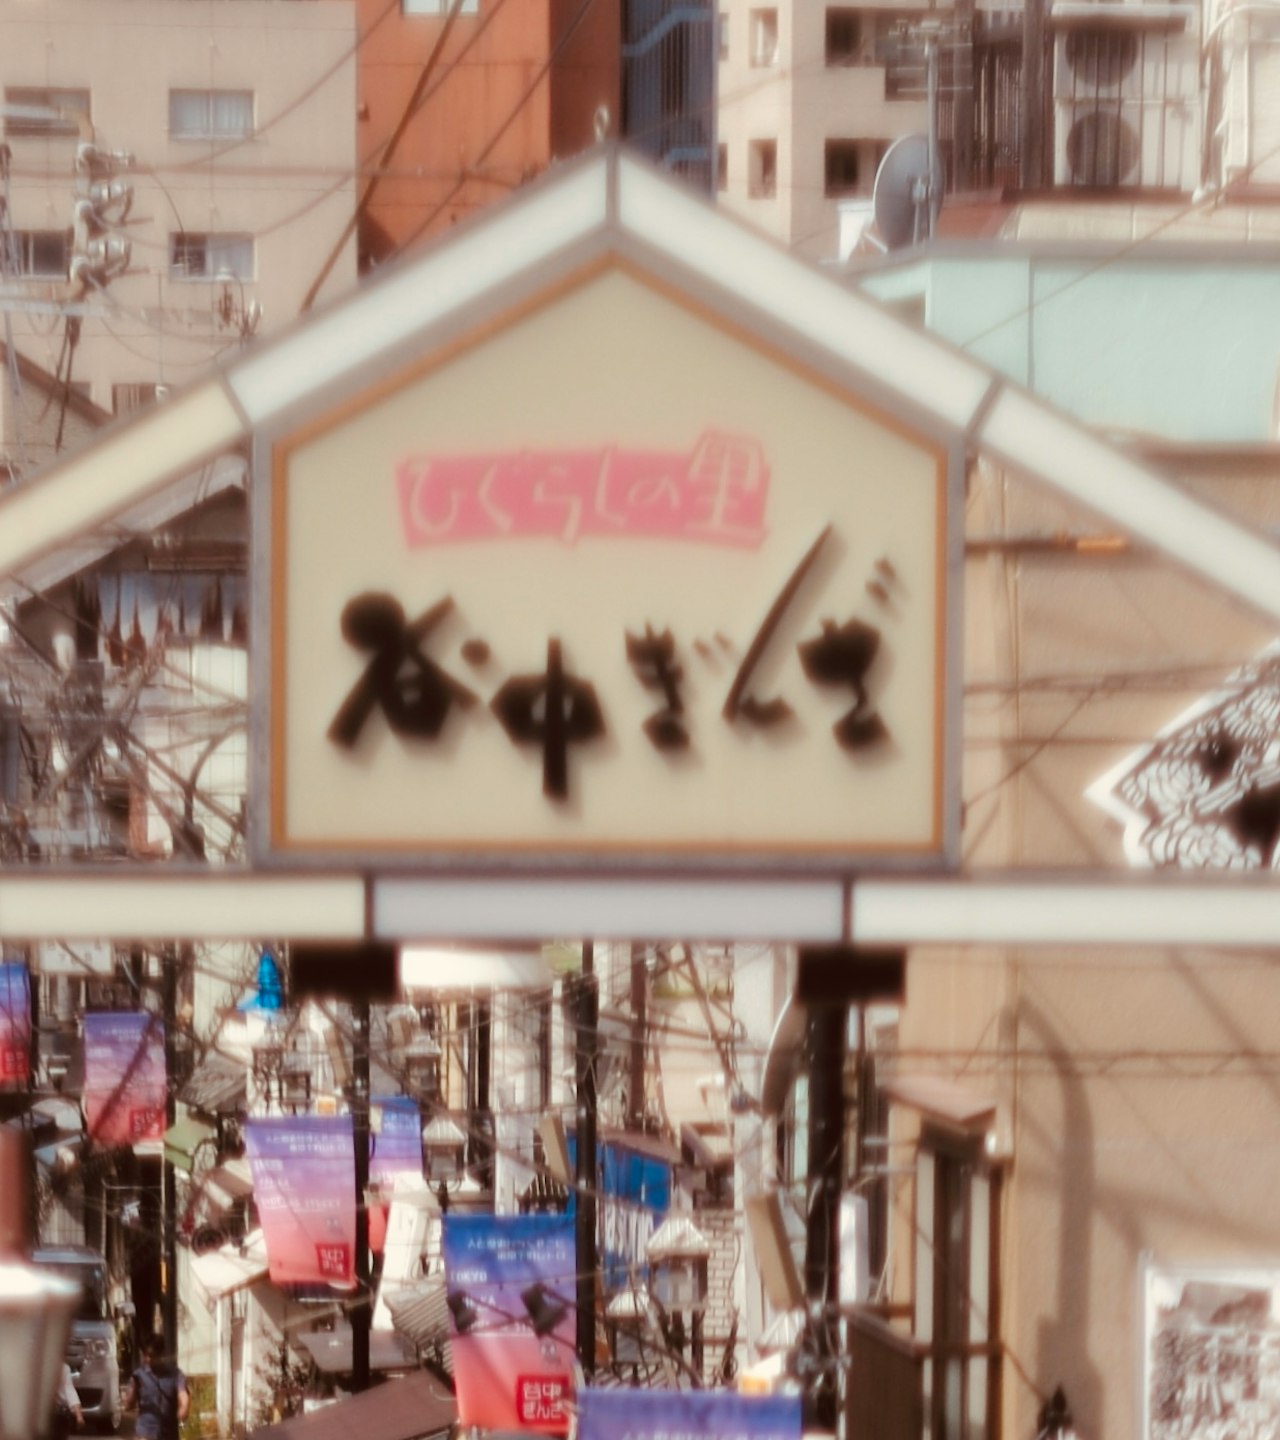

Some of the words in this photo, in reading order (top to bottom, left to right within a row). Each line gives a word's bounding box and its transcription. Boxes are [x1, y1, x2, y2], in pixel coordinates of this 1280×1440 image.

[405, 430, 770, 549] ひぐらしの里
[326, 522, 904, 803] 谷中ぎんざ
